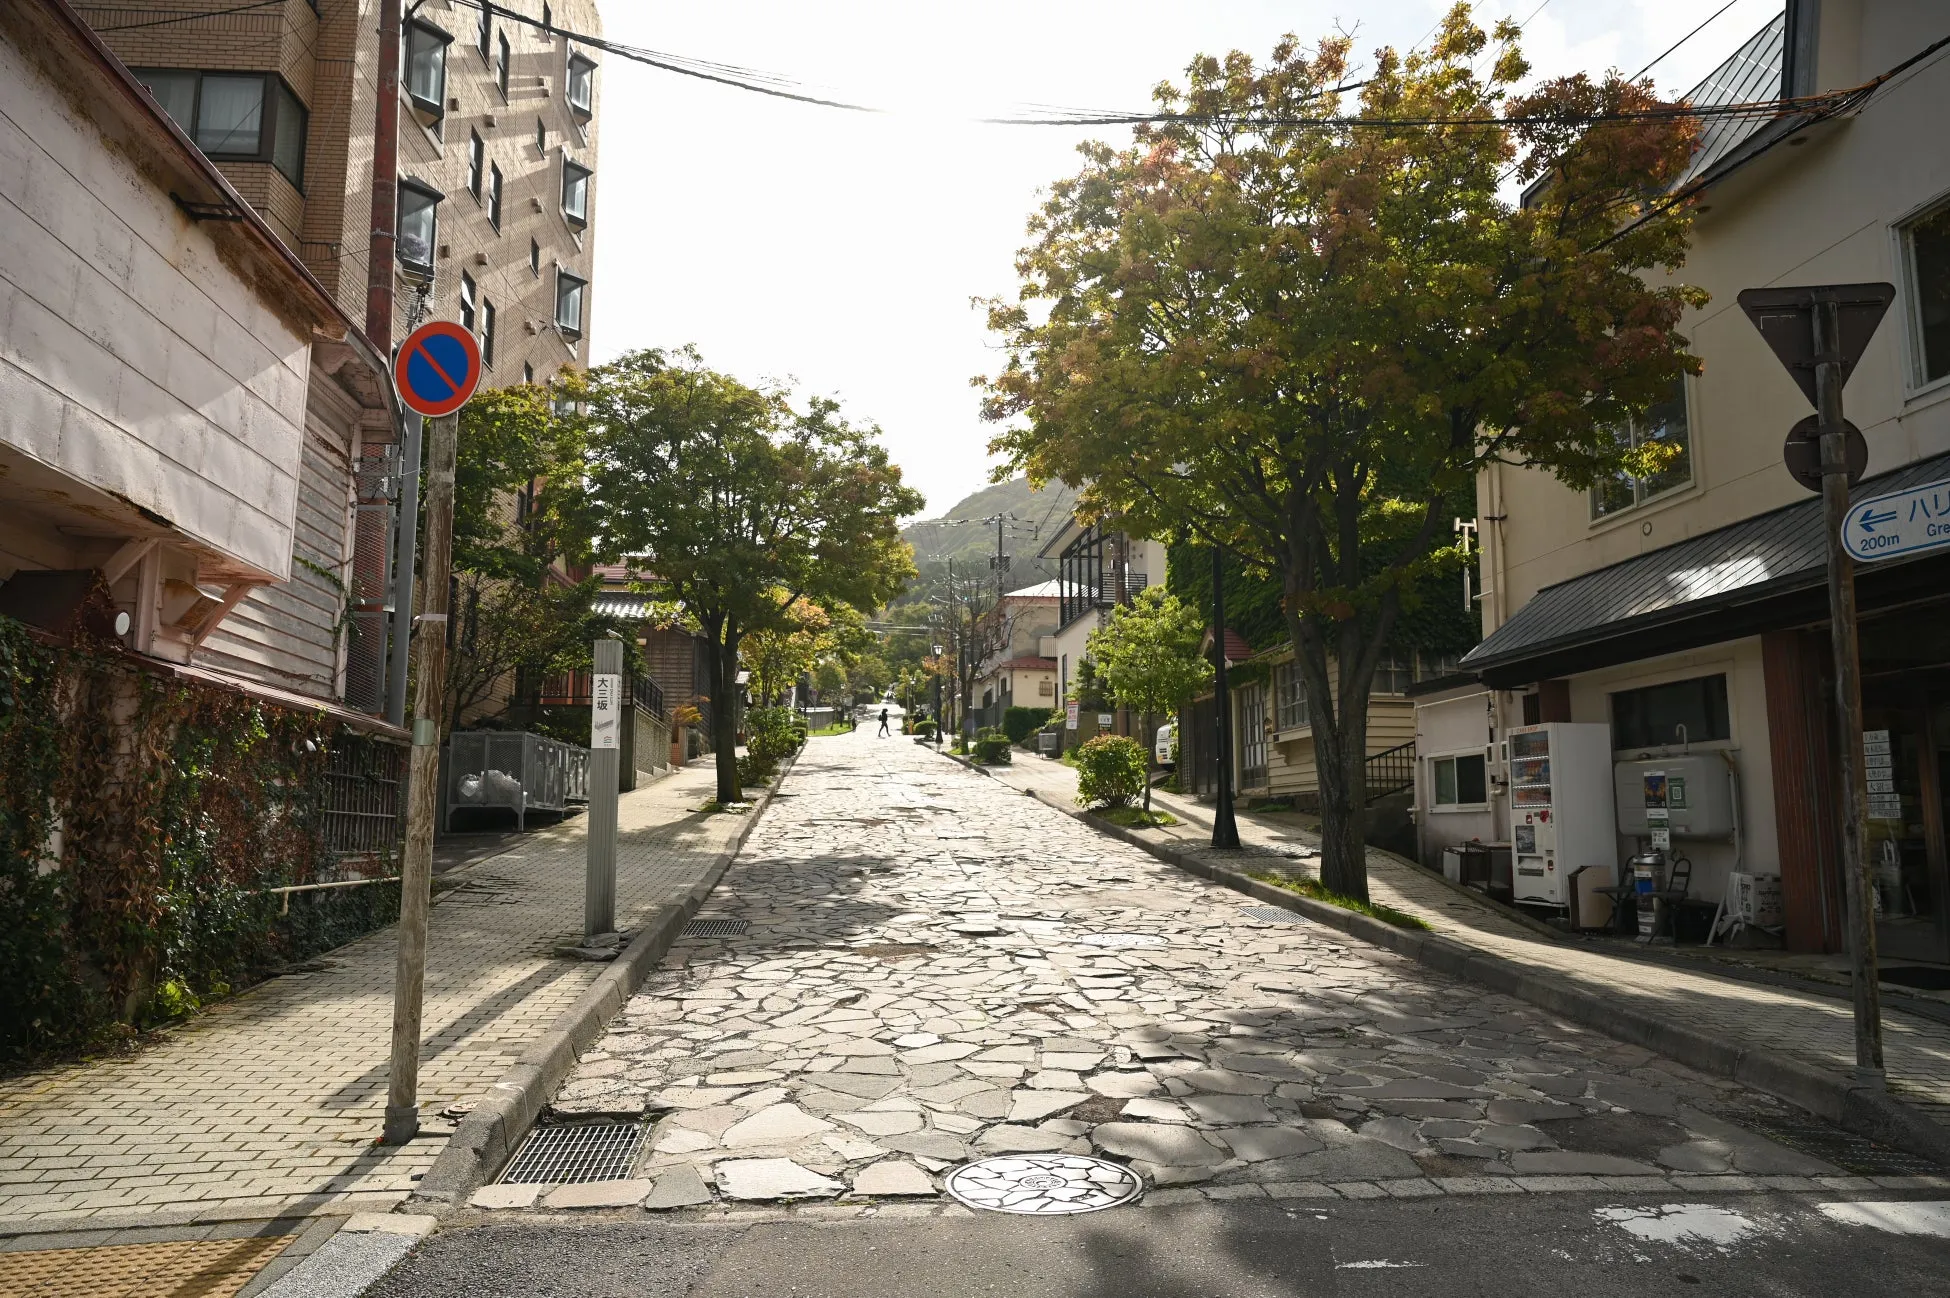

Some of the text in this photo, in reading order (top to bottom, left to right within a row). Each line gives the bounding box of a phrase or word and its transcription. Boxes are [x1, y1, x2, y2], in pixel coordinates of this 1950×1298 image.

[1860, 534, 1900, 552] 200m
[597, 677, 609, 711] 大三坂
